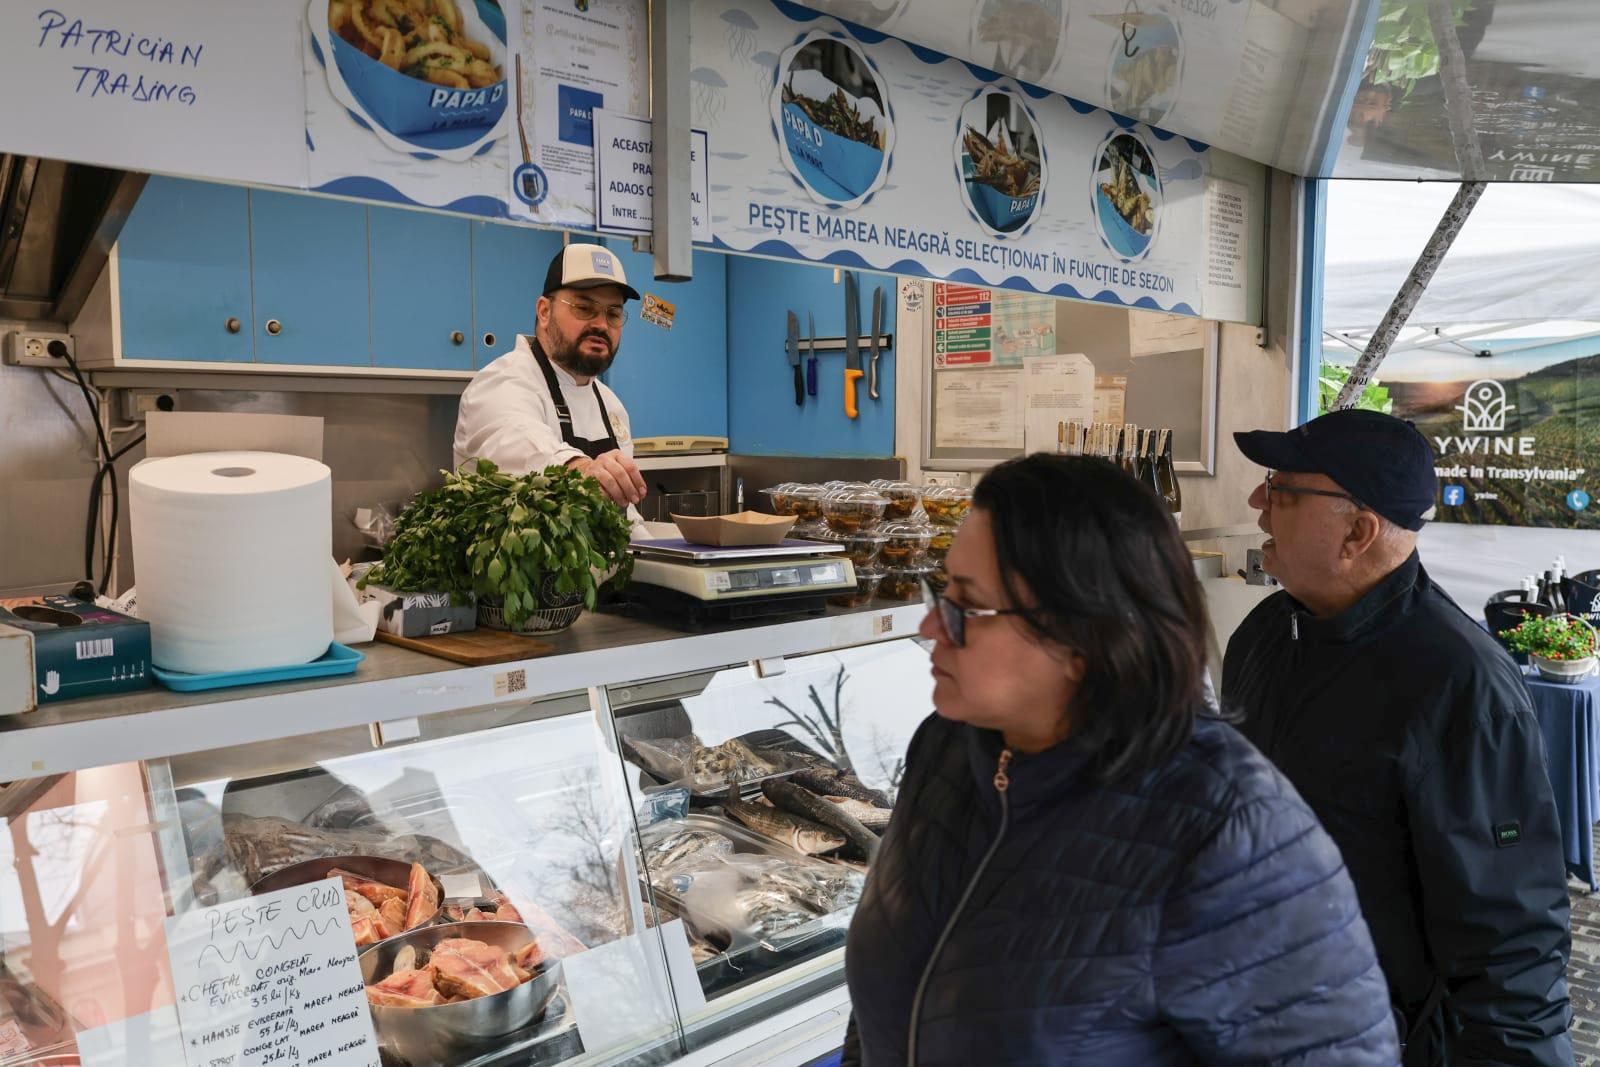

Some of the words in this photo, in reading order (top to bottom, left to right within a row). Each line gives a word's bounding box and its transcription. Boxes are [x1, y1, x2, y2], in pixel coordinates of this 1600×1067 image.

[38, 9, 204, 67] PATRICIAN
[72, 65, 197, 105] TRADING
[430, 88, 486, 109] PAPA
[490, 84, 504, 103] D
[784, 108, 812, 142] PAPA
[813, 127, 823, 147] D
[609, 181, 645, 196] ADAOS
[612, 204, 638, 219] ÎNTRE
[749, 203, 811, 235] PEȘTE
[816, 214, 880, 245] MAREA
[884, 226, 951, 257] NEAGRĂ
[955, 239, 1049, 273] SELECȚIONAT
[1052, 252, 1066, 275] ÎN
[1069, 260, 1119, 287] FUNCȚIE
[1121, 267, 1137, 286] DE
[1139, 270, 1174, 293] SEZON
[1434, 436, 1536, 456] YWINE
[1470, 465, 1484, 478] in
[205, 900, 283, 941] PEȘTE
[296, 886, 341, 913] CRUD
[255, 953, 313, 980] CONGELAT
[303, 995, 333, 1010] MAREA
[243, 1035, 290, 1057] CONGELAT
[299, 1022, 325, 1037] MAREA
[259, 1027, 271, 1039] 55
[307, 1051, 333, 1065] MAREA
